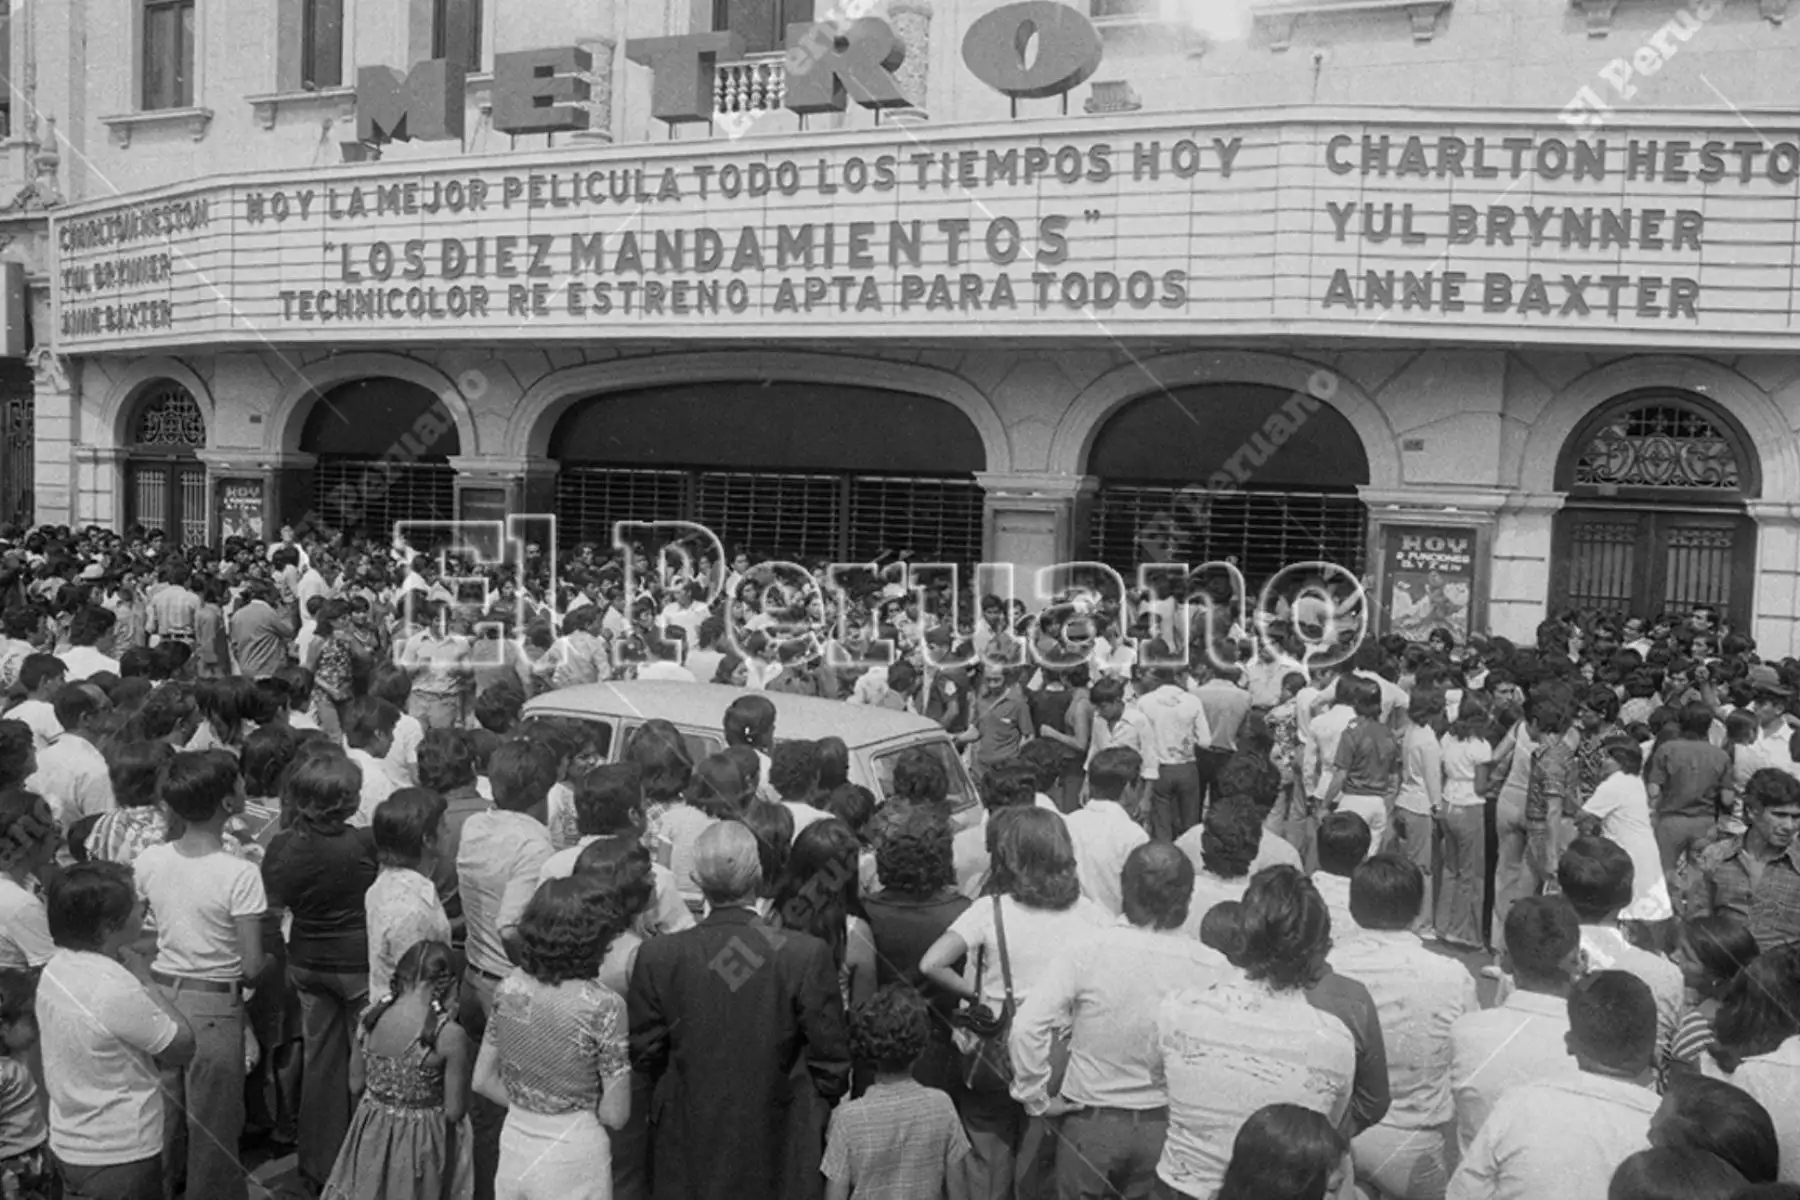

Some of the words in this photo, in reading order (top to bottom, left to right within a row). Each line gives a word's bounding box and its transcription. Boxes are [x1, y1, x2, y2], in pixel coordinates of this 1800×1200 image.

[355, 0, 1104, 147] METRO
[246, 187, 315, 223] HOY
[328, 185, 368, 221] LA
[376, 178, 489, 216] MEJOR
[502, 167, 682, 210] PELICULA
[692, 160, 800, 203] TODO
[817, 155, 897, 195] LOS
[910, 143, 1113, 191] TIEMPOS
[1132, 137, 1243, 182] HOY
[1326, 134, 1607, 182] CHARLTON
[1327, 201, 1427, 245] YUL
[1448, 203, 1704, 252] BRYNNER
[440, 233, 555, 281] DIEZ
[279, 284, 490, 323] TECHNICOLOR
[507, 283, 551, 318] RE
[562, 276, 750, 316] ESTRENO
[772, 272, 884, 314] APTA
[901, 271, 1015, 312] PARA
[1030, 269, 1188, 310] TODOS
[1321, 268, 1467, 313] ANNE
[1482, 272, 1700, 319] BAXTER
[1401, 535, 1468, 553] HOY
